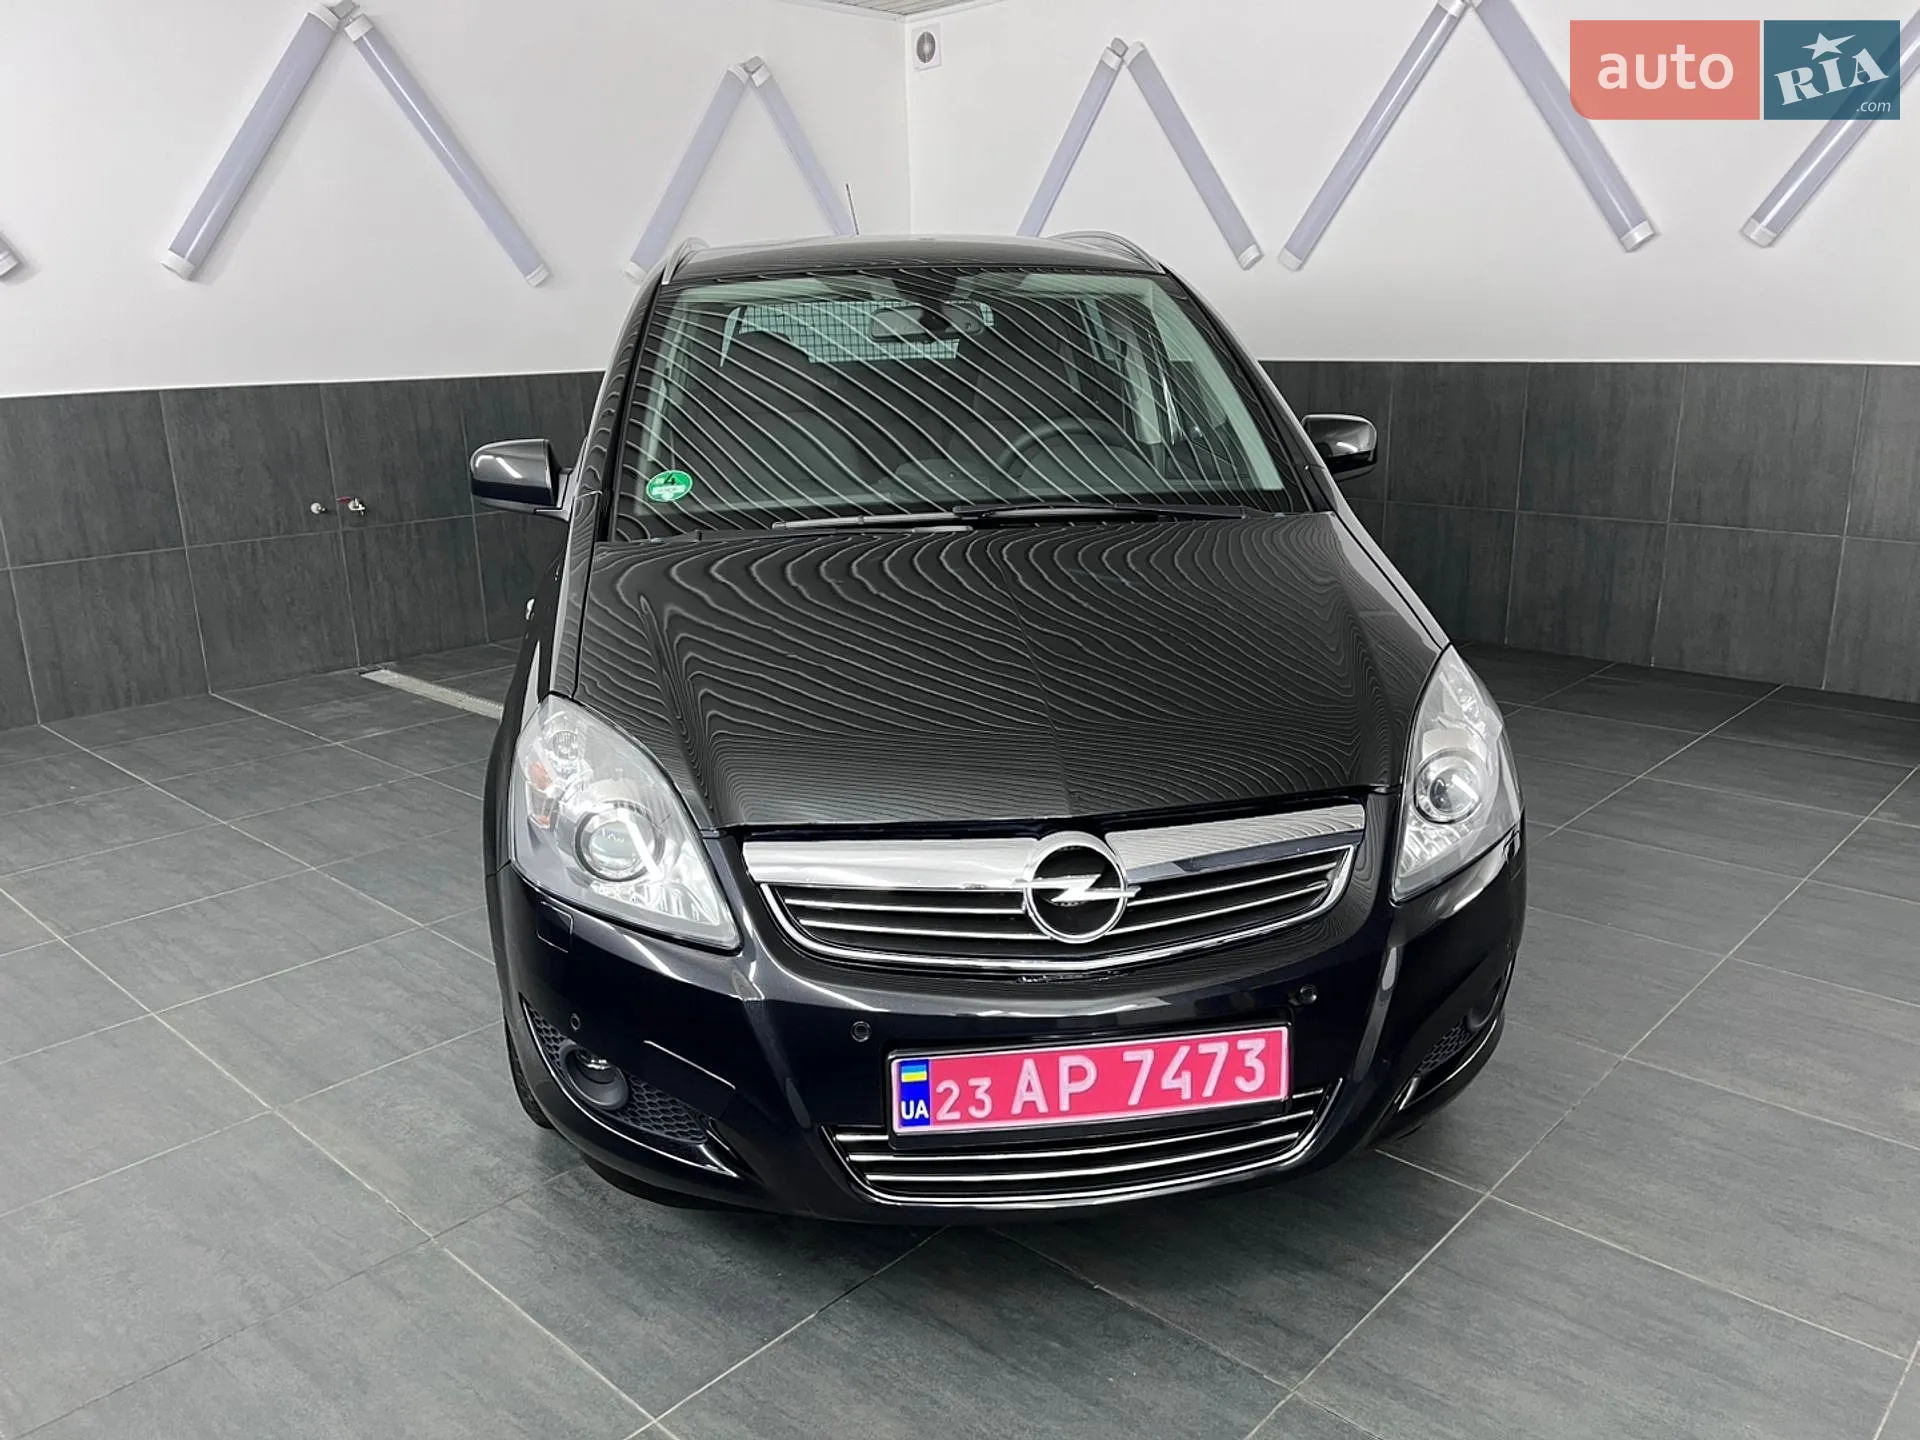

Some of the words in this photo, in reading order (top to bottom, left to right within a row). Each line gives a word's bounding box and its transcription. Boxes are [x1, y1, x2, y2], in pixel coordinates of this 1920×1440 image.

[936, 1077, 993, 1121] 23
[1011, 1055, 1097, 1115] AP
[1122, 1038, 1267, 1106] 7473
[901, 1101, 929, 1120] UA
